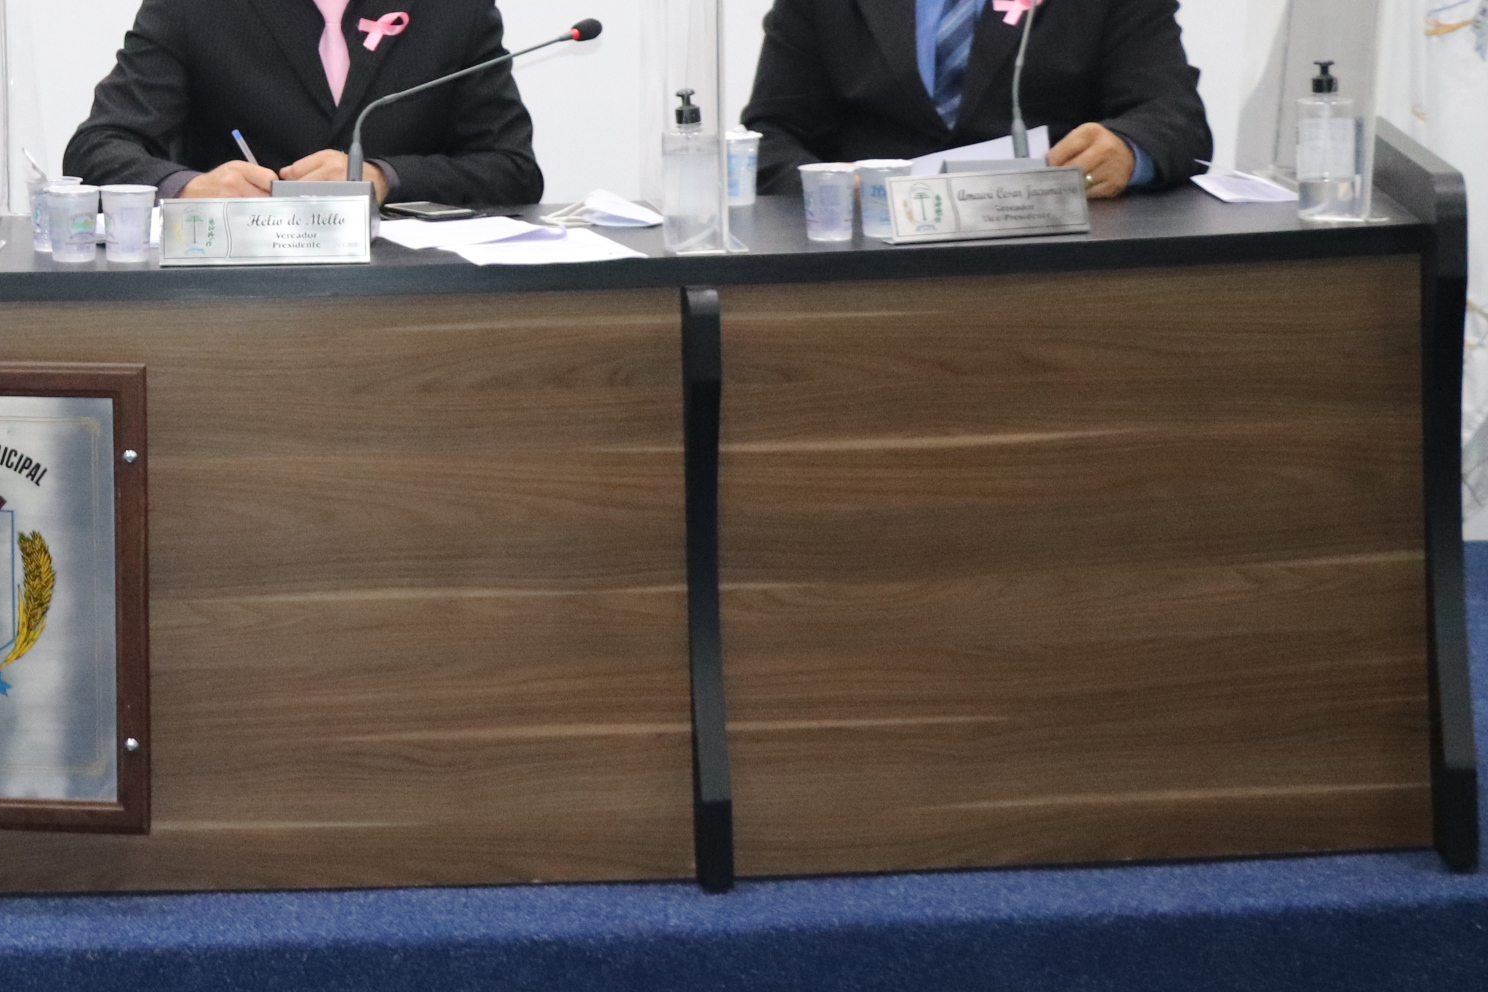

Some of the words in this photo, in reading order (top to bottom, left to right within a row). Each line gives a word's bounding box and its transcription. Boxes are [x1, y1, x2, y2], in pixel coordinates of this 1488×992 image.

[287, 214, 301, 226] de
[306, 213, 345, 226] Mello
[275, 231, 317, 240] Vereador
[272, 241, 321, 249] Presidente
